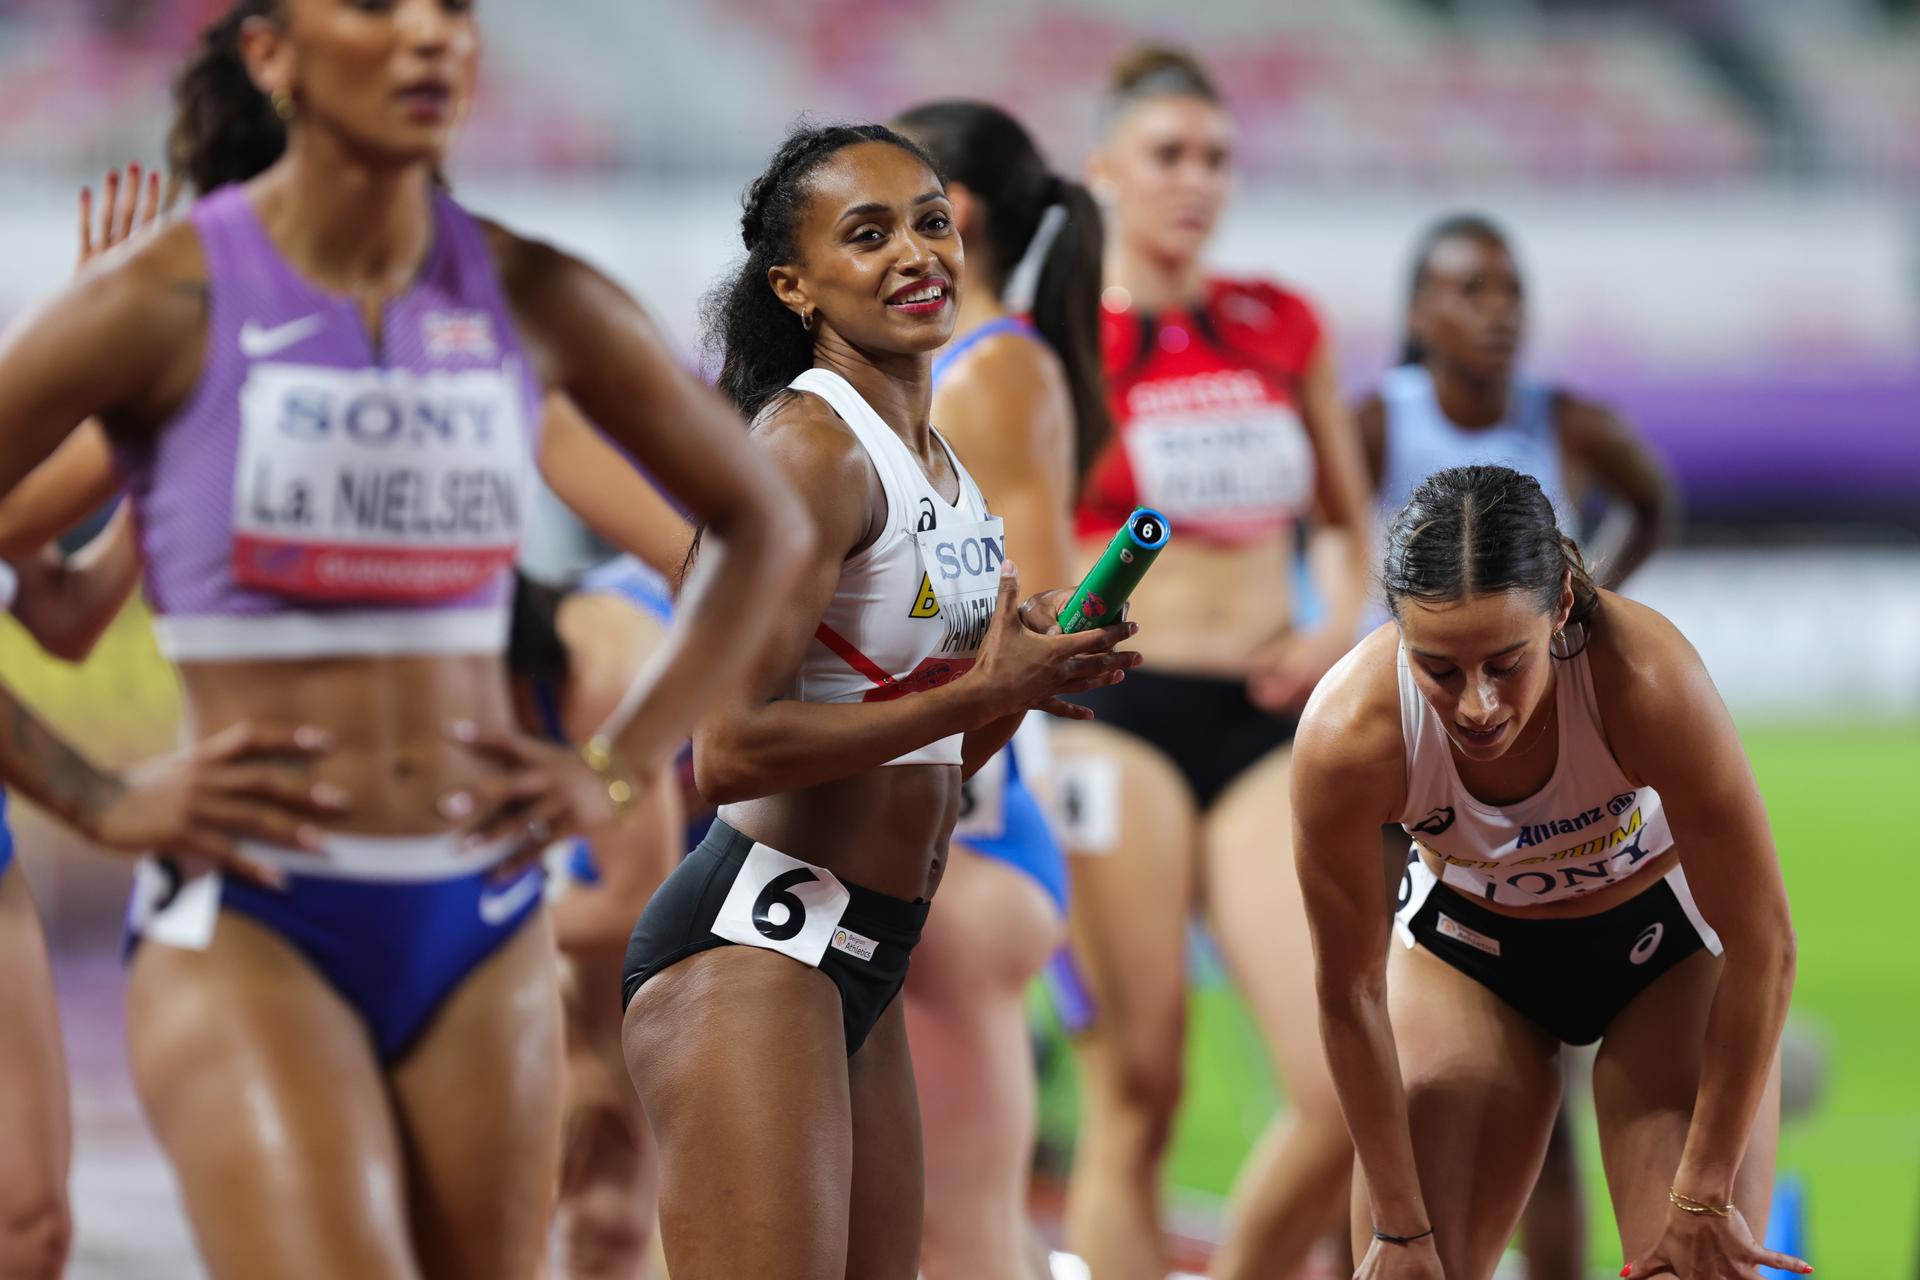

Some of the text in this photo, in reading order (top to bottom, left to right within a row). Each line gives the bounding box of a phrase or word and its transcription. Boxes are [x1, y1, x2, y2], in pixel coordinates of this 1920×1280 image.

[278, 386, 494, 447] SONY
[250, 456, 522, 534] La NIELSEN
[1142, 523, 1154, 539] 6
[1515, 807, 1605, 849] Allianz
[1500, 822, 1650, 898] ONY
[752, 867, 820, 941] 6
[845, 942, 871, 959] Athletics
